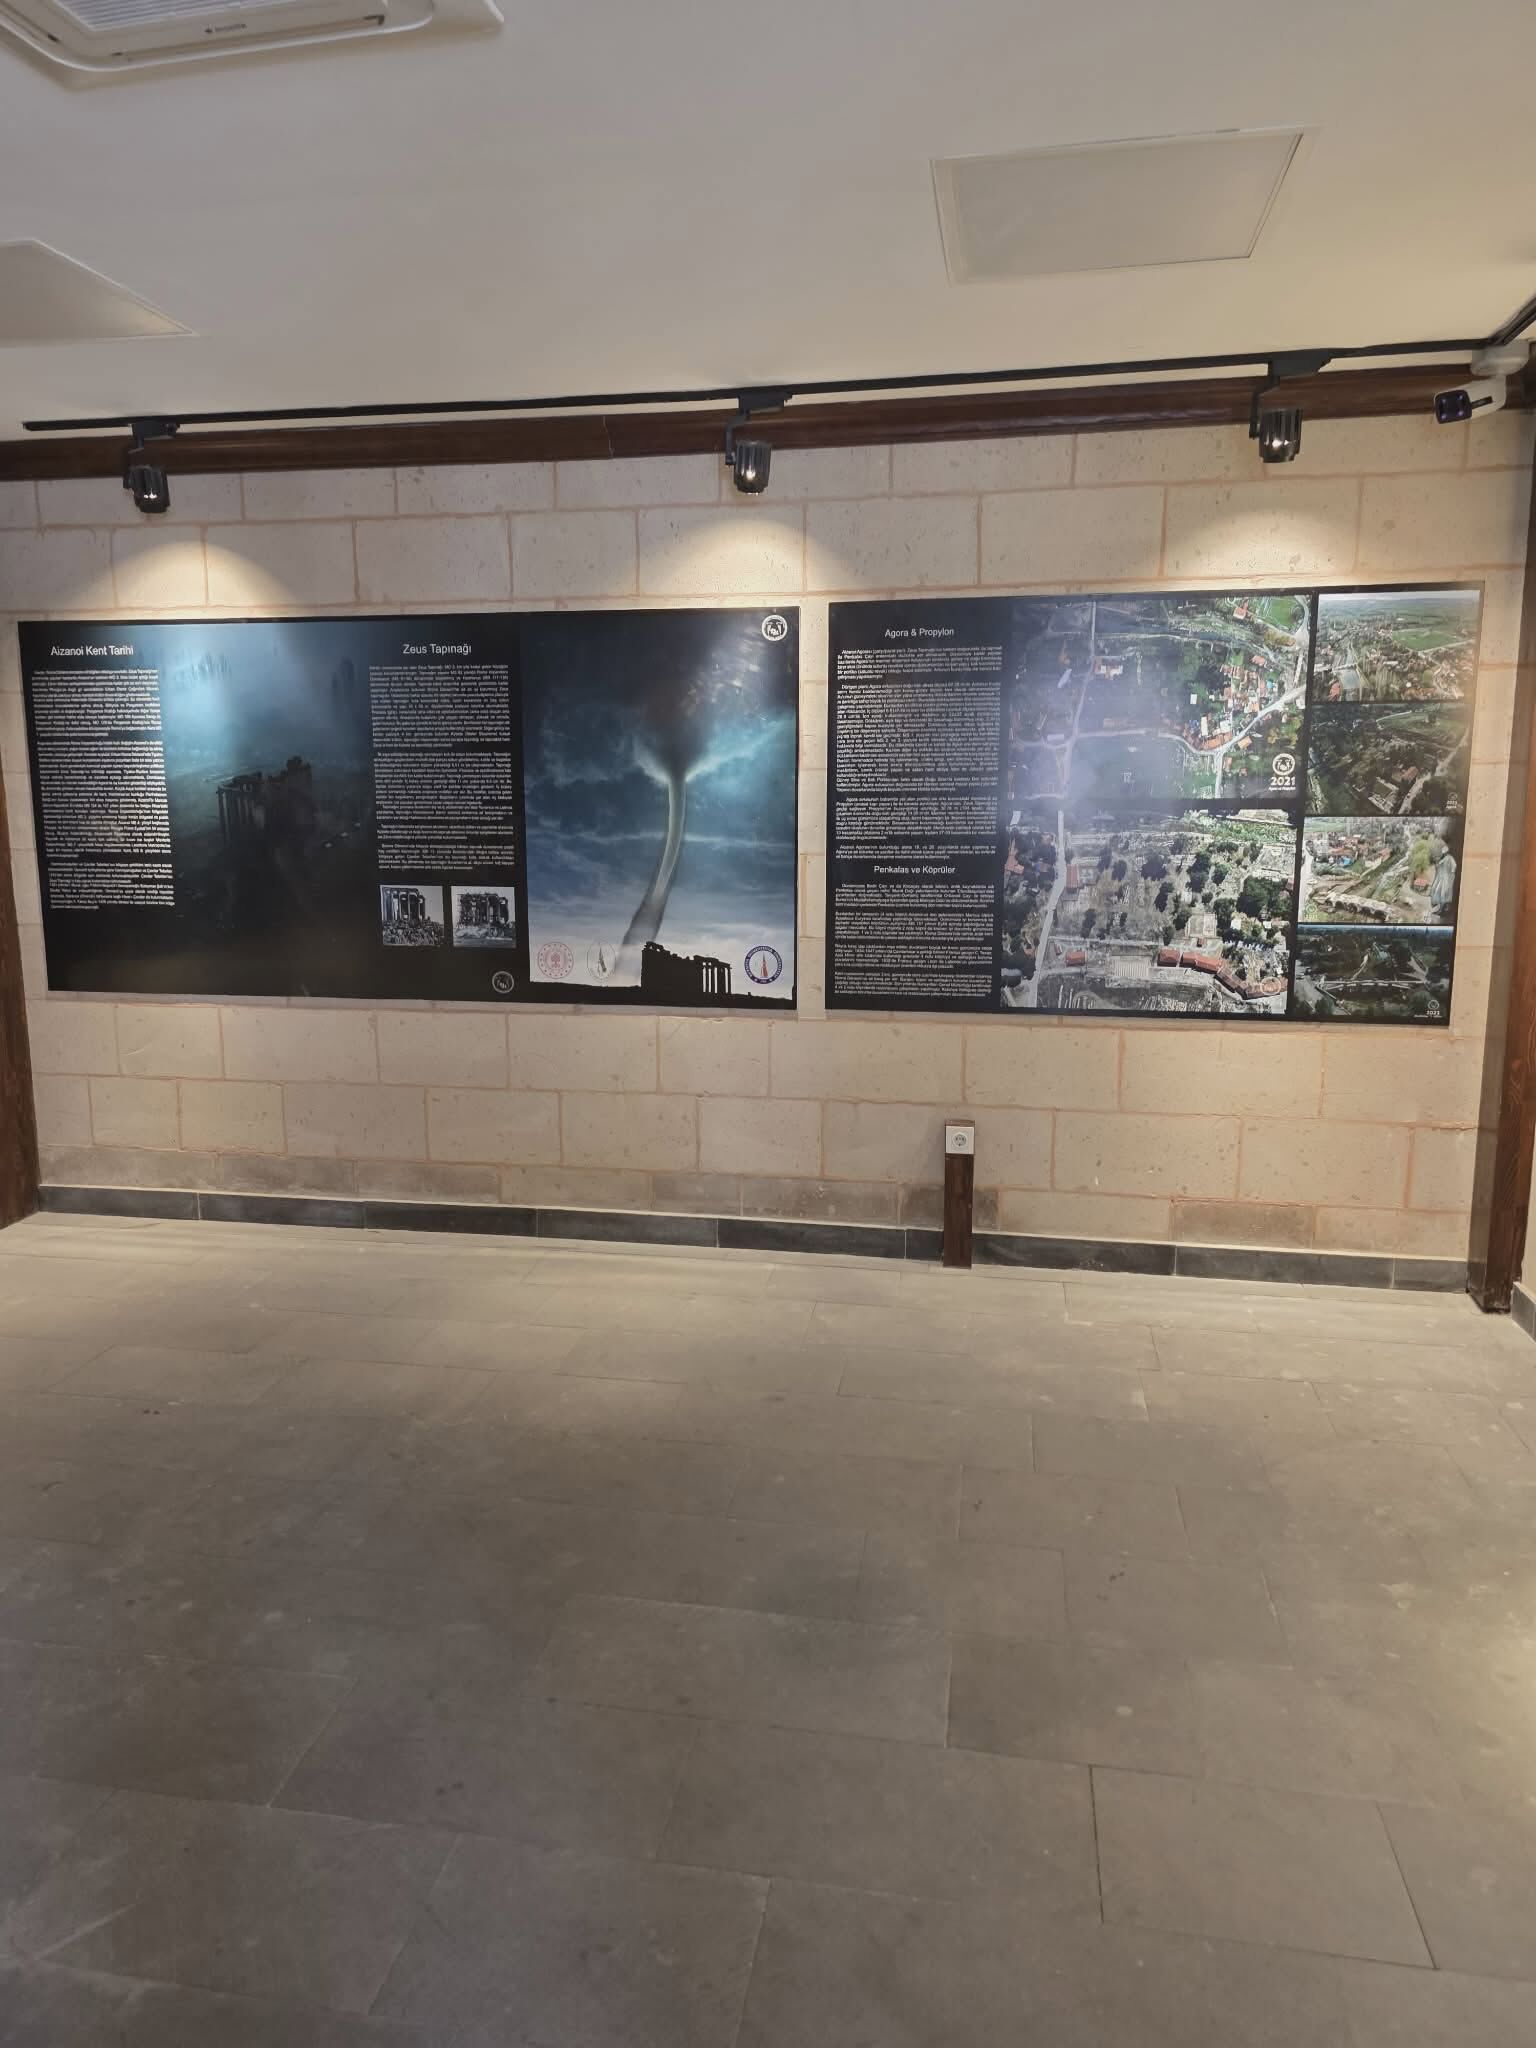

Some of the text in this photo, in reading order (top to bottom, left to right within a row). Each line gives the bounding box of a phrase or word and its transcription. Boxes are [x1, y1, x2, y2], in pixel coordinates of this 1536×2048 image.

[885, 627, 954, 639] Agora & Propylon
[50, 645, 134, 656] Aizanoi Kent Tarihi
[403, 643, 472, 656] Zeus Tapınağı
[1271, 776, 1296, 786] 2021
[922, 865, 956, 875] Köprüler
